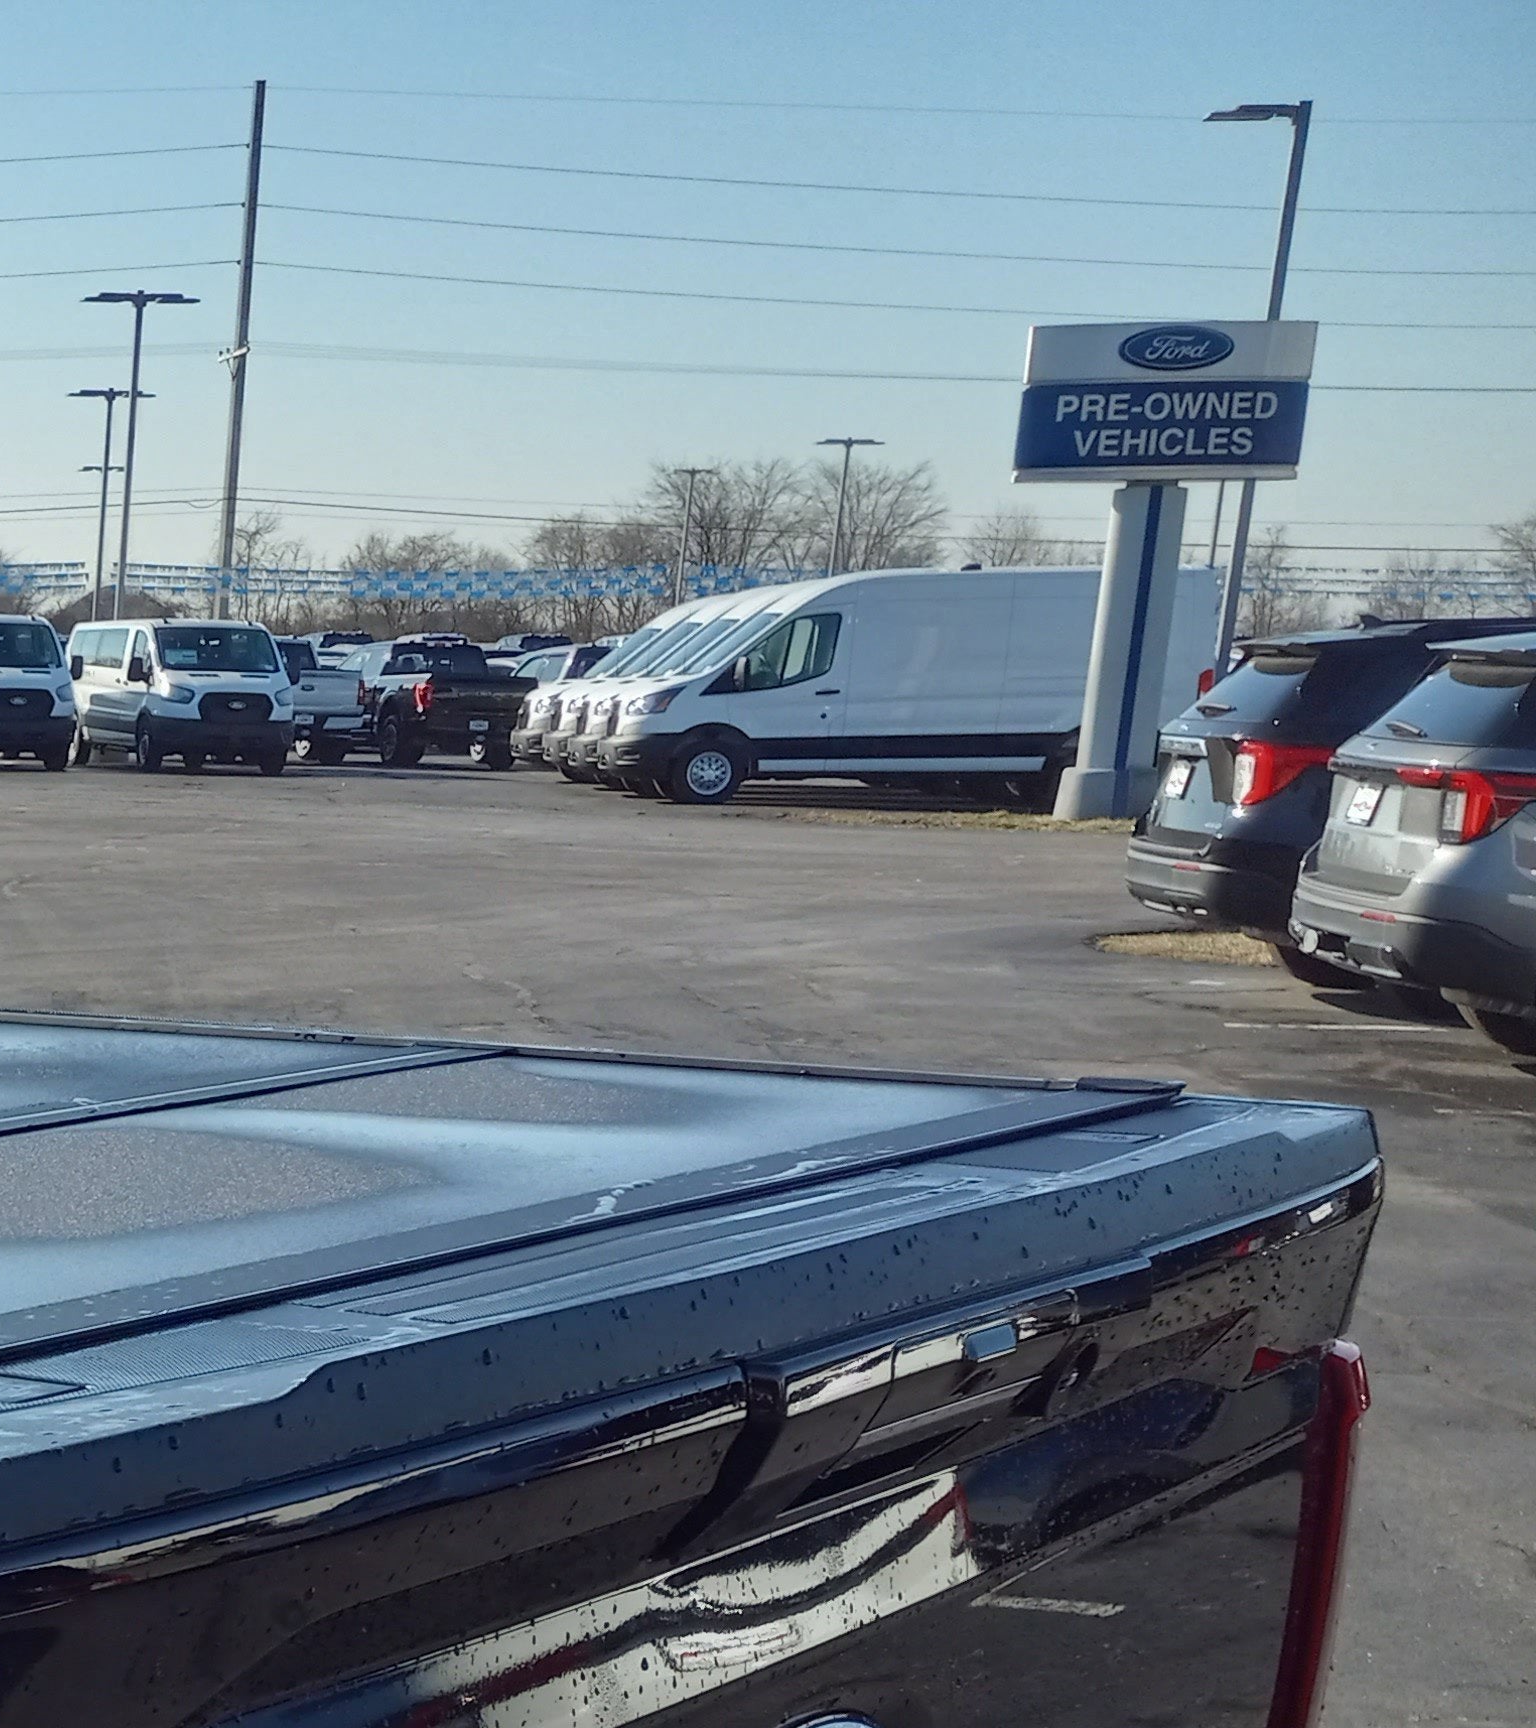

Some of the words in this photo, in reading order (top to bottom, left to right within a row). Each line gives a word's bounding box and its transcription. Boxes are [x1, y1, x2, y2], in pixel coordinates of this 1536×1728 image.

[1145, 335, 1212, 360] Ford
[1055, 391, 1278, 423] PRE-OWNED
[1073, 426, 1254, 458] VEHICLES
